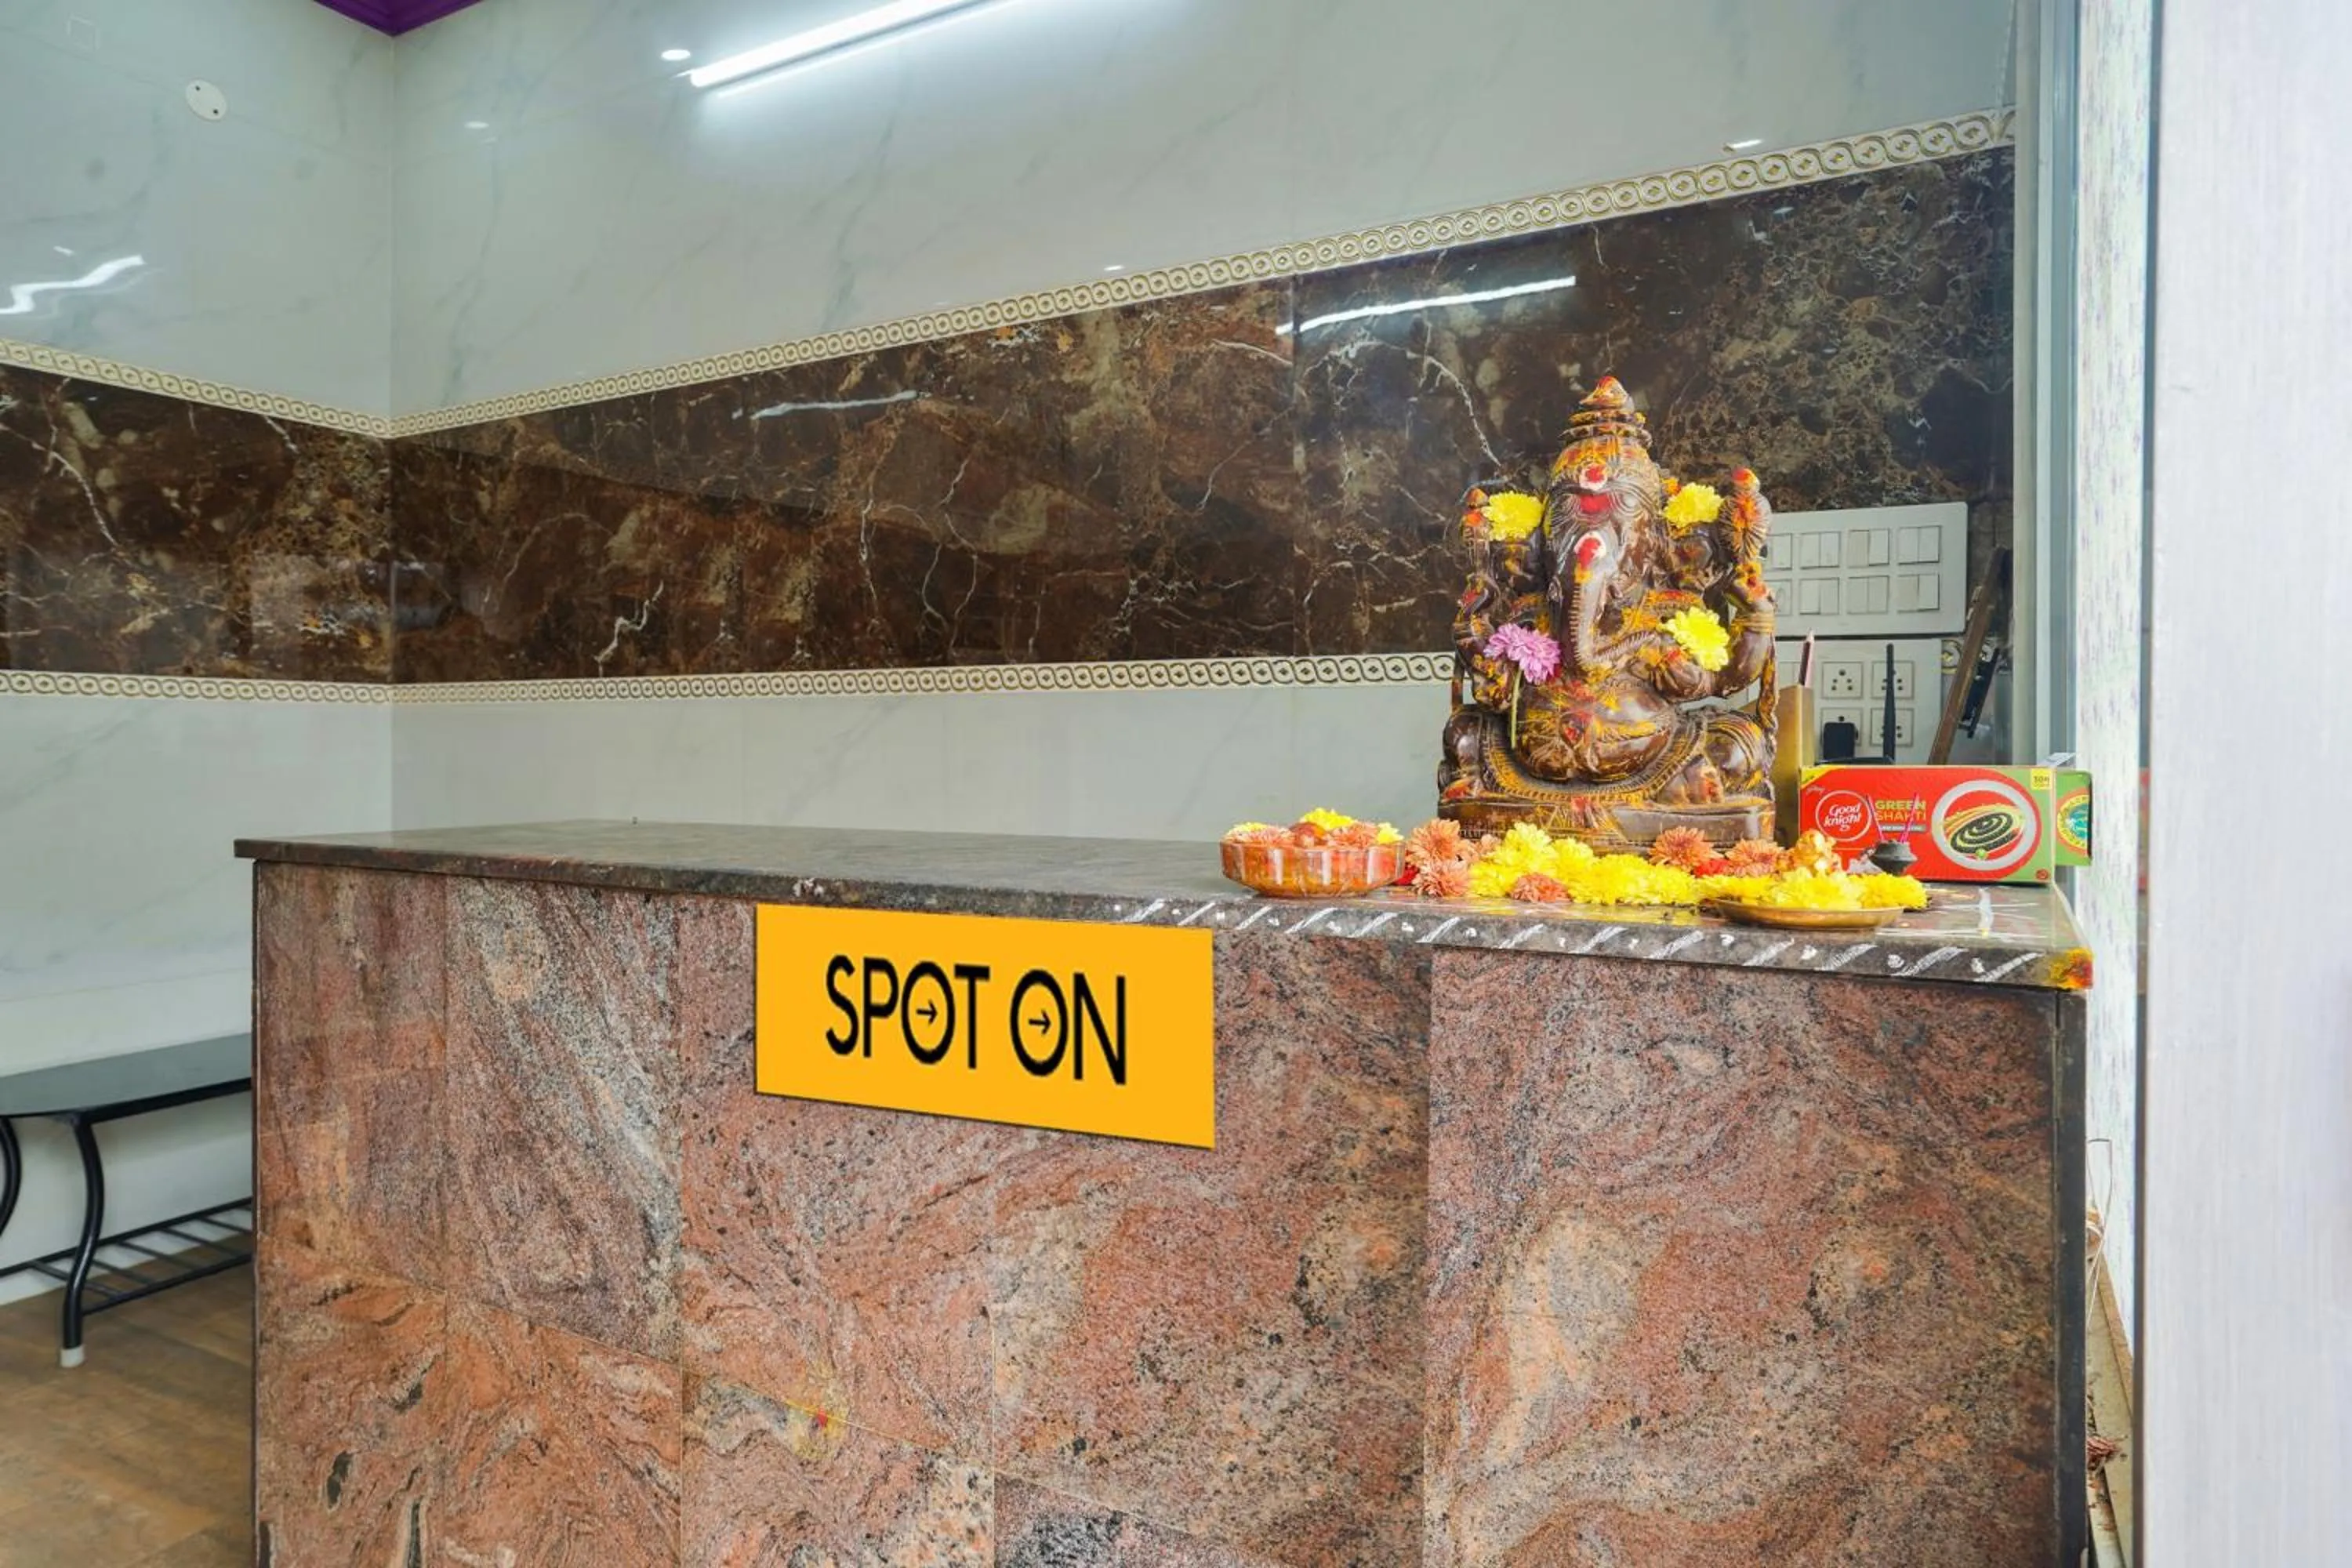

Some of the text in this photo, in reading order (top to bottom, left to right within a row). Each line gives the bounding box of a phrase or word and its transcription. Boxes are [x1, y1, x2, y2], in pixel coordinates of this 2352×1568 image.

[1829, 803, 1861, 817] Good
[1824, 813, 1861, 832] knight
[826, 955, 1126, 1085] SPOT ON
